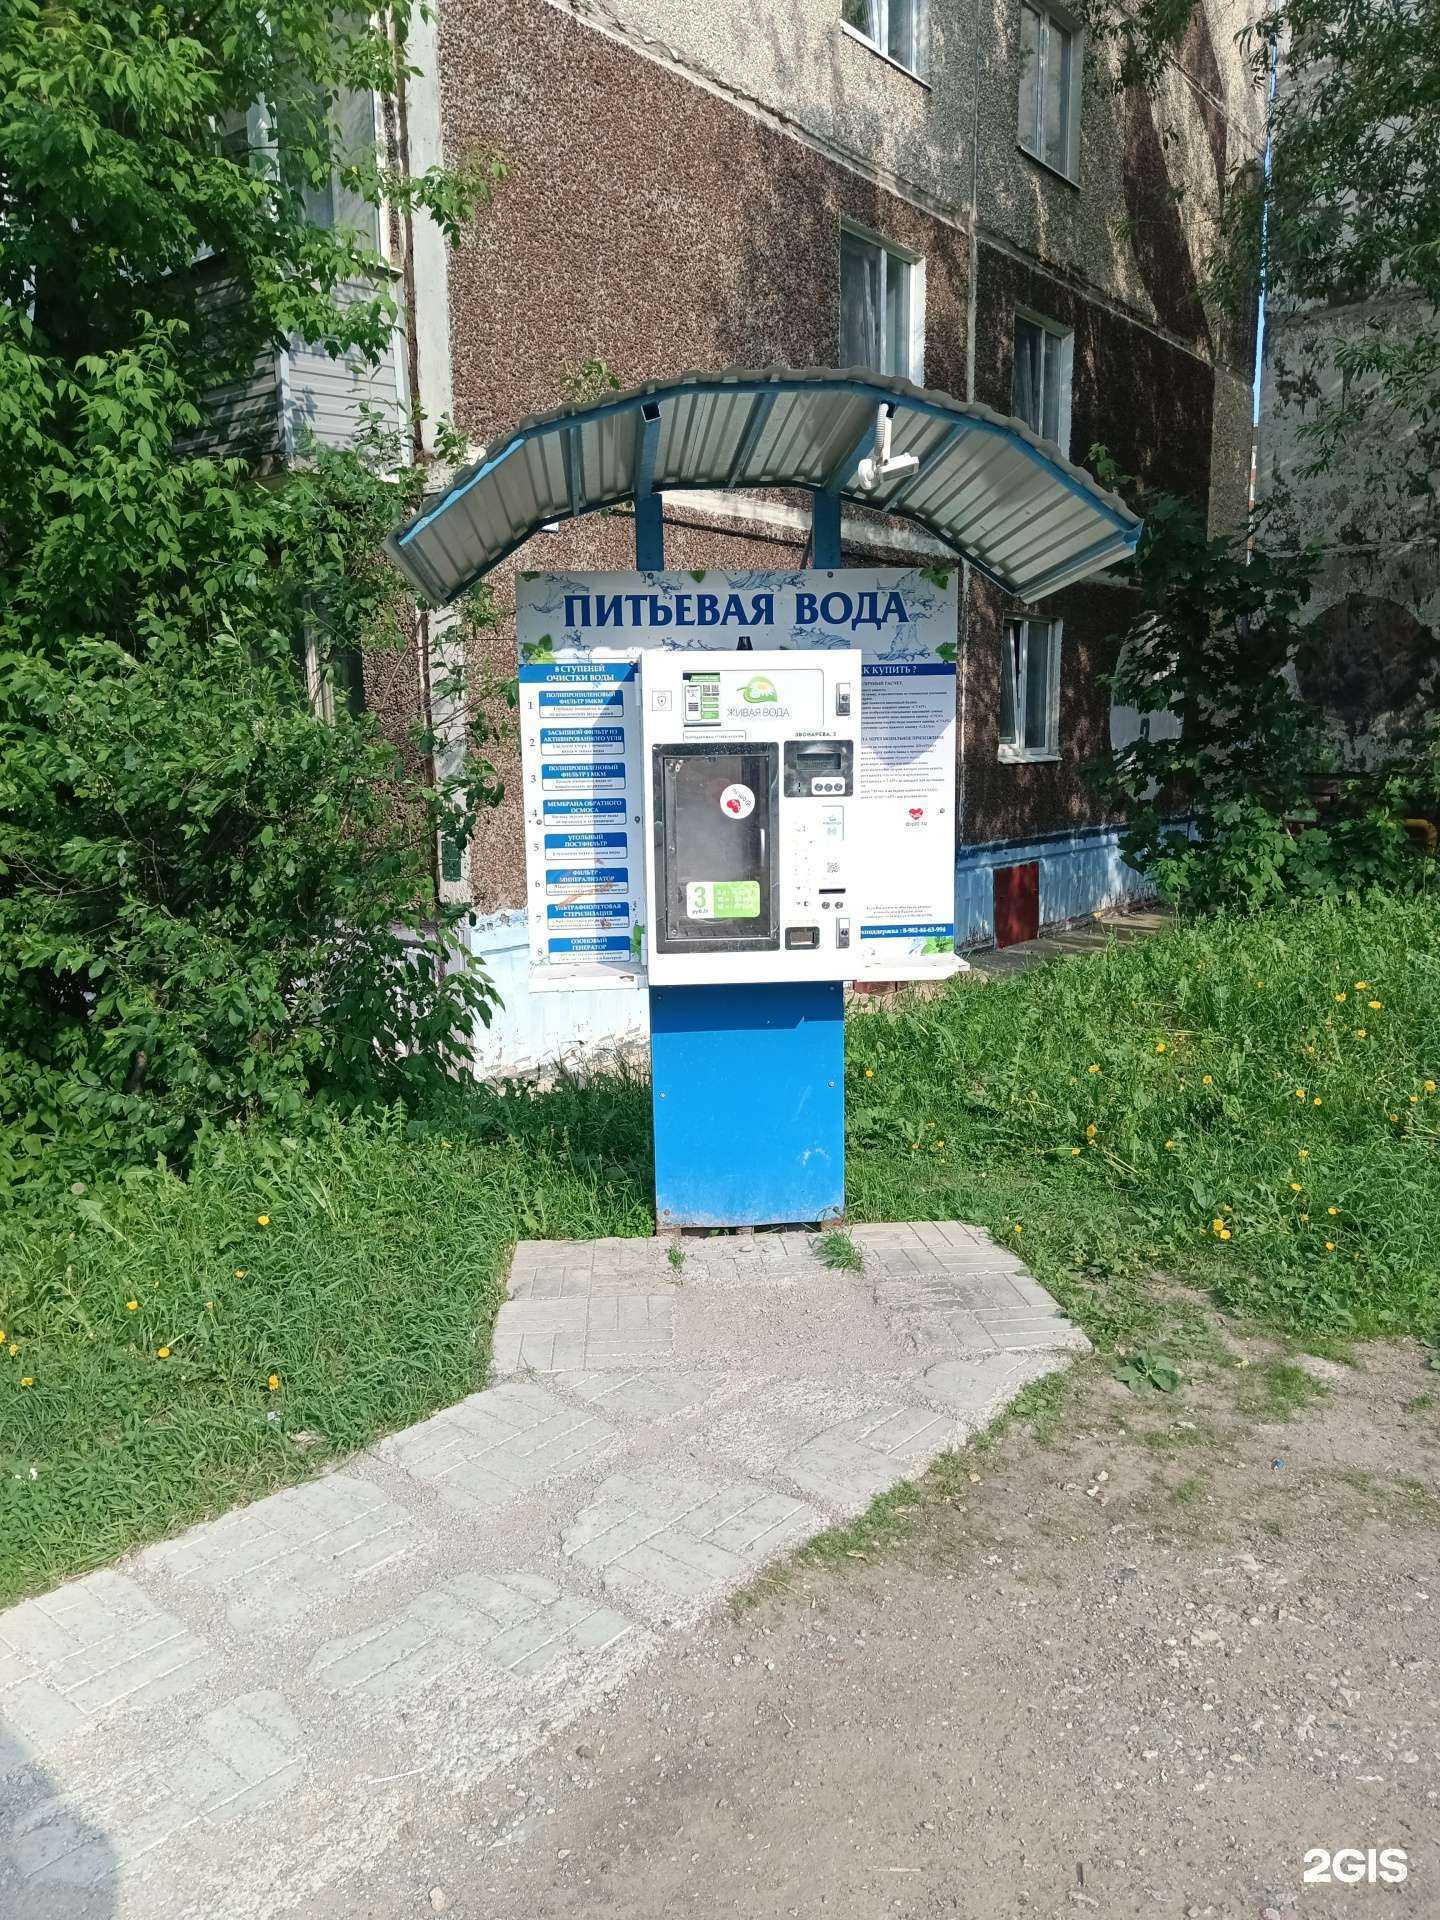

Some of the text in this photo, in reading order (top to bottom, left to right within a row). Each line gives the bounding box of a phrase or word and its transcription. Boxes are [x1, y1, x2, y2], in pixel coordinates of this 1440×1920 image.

[563, 591, 910, 632] ПИТЬЕВАЯ ВОДА
[560, 665, 605, 673] СТУПЕНЕЙ
[872, 666, 911, 675] КУПИТЬ
[546, 674, 614, 682] ОЧИСТКИ ВОДЫ
[528, 701, 533, 710] 1
[727, 708, 790, 717] ЖИВАЯ ВОДА
[529, 739, 536, 747] 2
[530, 775, 537, 784] 3
[533, 844, 539, 852] 5
[535, 880, 541, 888] 6
[694, 886, 706, 908] 3
[536, 915, 541, 923] 7
[537, 948, 543, 956] 8
